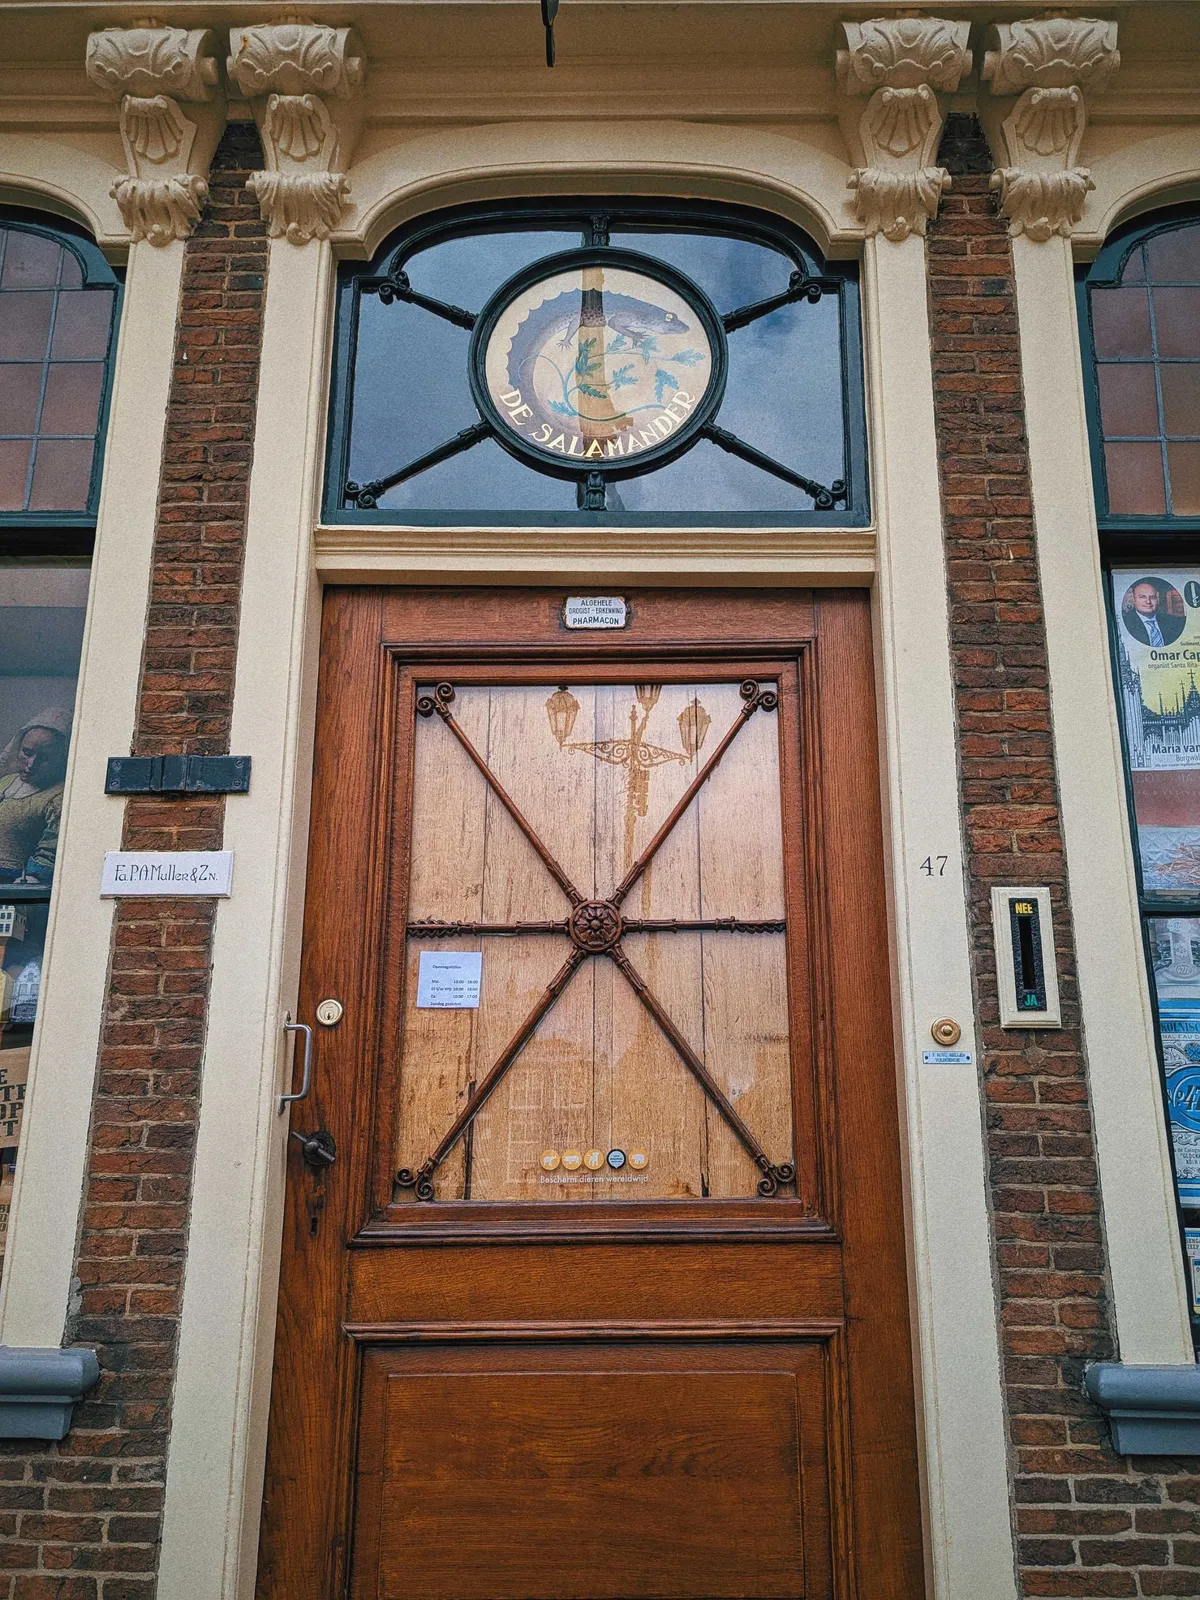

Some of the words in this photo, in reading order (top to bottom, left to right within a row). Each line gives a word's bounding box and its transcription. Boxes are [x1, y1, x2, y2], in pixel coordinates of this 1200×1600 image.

[498, 388, 534, 426] DE
[528, 389, 696, 458] SALAMANDER
[572, 616, 620, 625] PHARMACON
[1150, 650, 1180, 661] Omar
[1183, 649, 1200, 663] Cap
[1152, 744, 1181, 754] Maria
[1183, 744, 1200, 753] van
[919, 855, 948, 877] 47
[1014, 902, 1033, 914] NEE
[1024, 994, 1038, 1006] JA
[579, 1175, 604, 1183] dieren
[604, 1175, 649, 1183] wereldwijd
